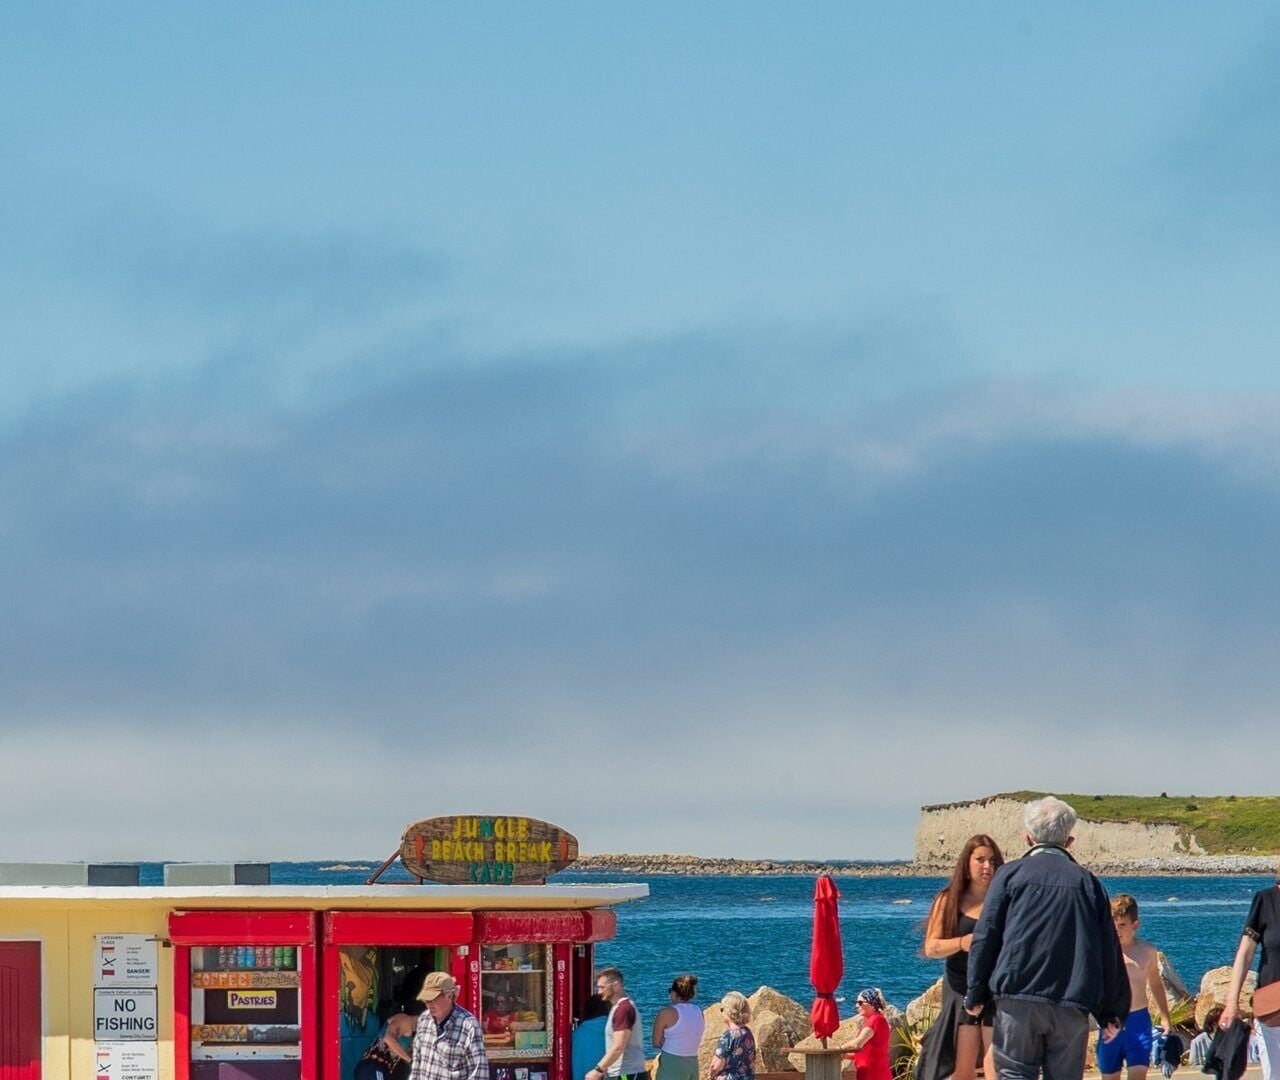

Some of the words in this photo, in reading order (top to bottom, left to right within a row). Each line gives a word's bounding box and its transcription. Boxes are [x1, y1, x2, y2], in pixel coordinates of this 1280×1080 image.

[453, 817, 528, 838] JUNGLE
[432, 839, 485, 861] BEACH
[494, 841, 552, 862] BREAK
[470, 862, 514, 885] CAFE
[114, 998, 136, 1012] NO
[230, 993, 275, 1007] PASTRIES
[96, 1017, 155, 1031] FISHING
